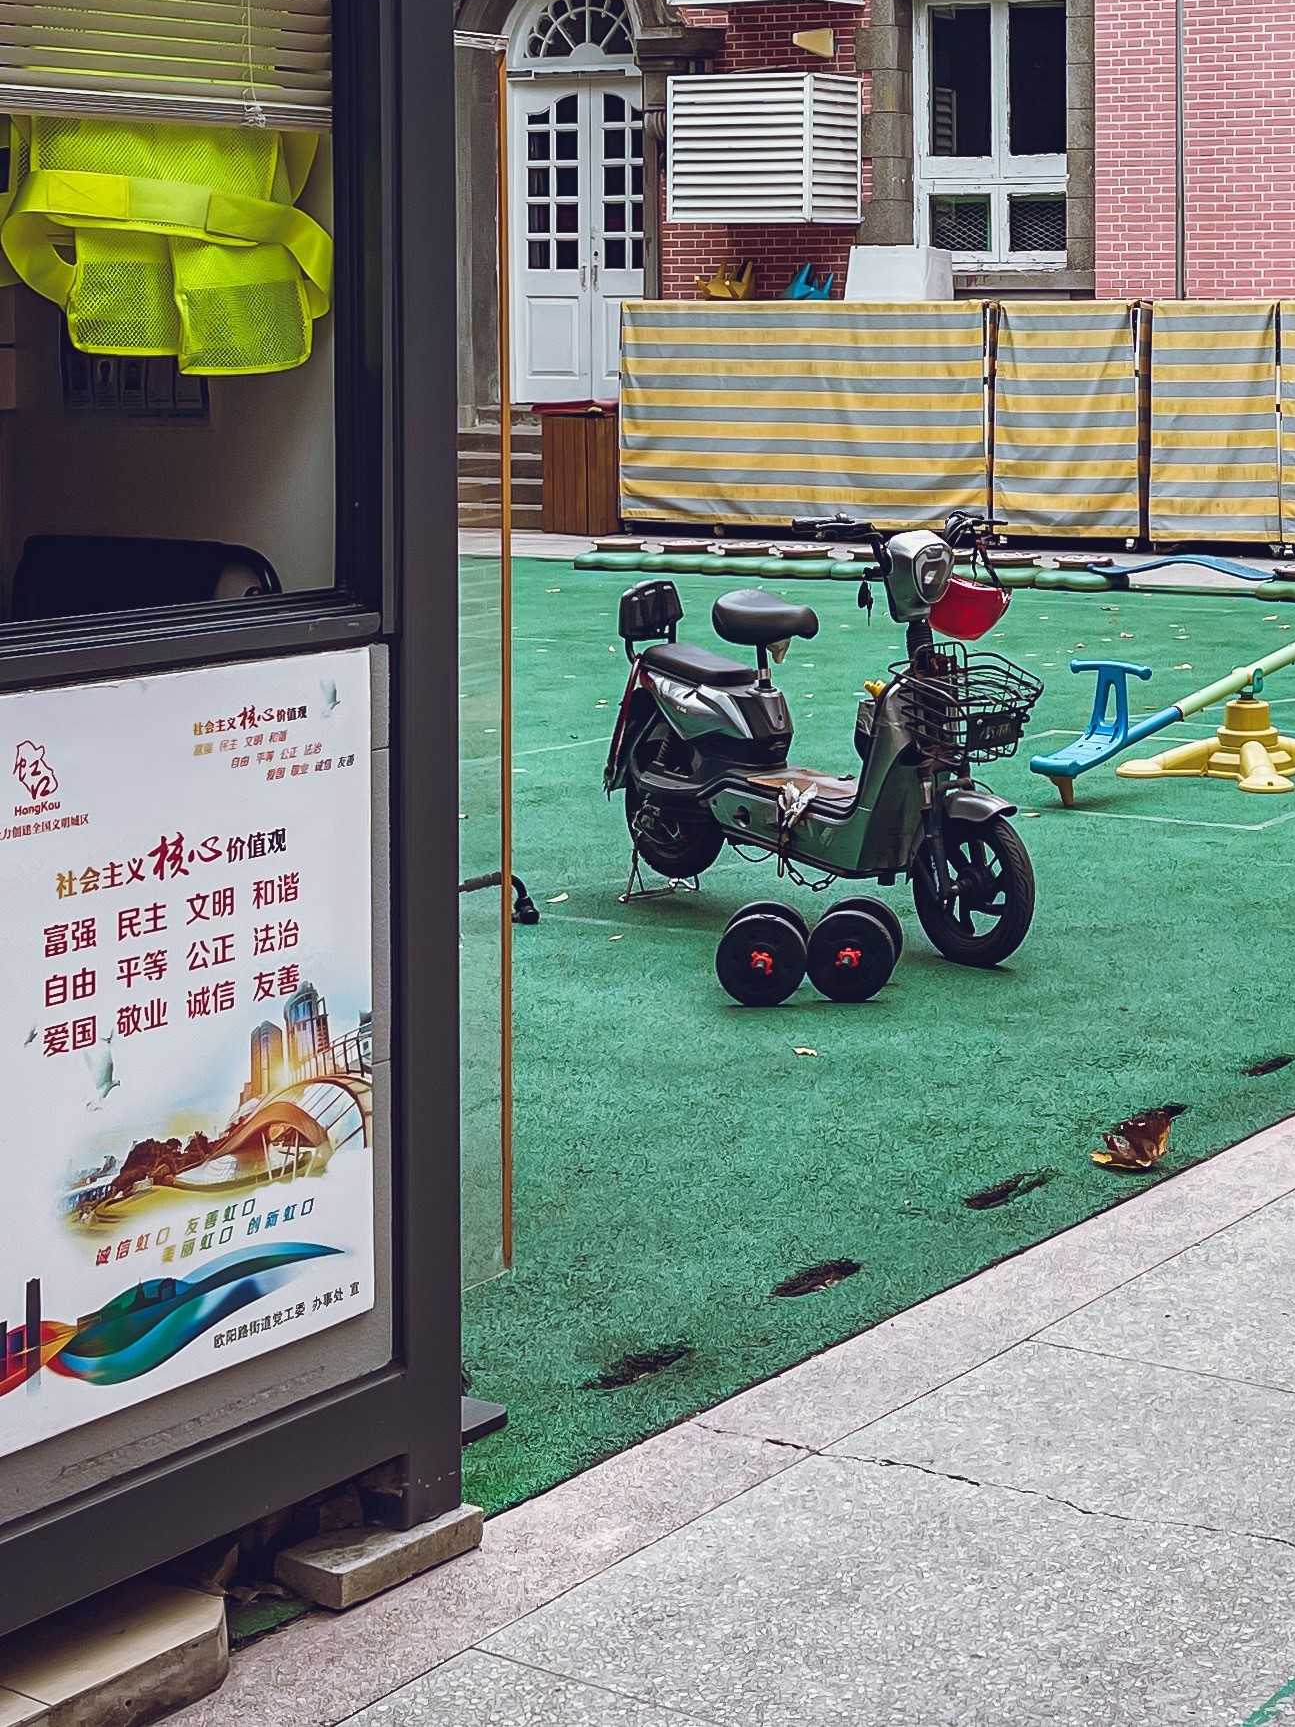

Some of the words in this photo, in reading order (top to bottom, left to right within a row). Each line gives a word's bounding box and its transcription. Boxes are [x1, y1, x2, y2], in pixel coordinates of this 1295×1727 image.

[14, 800, 61, 817] HongKou
[56, 828, 288, 900] 社会主义核心价值观
[43, 917, 98, 958] 富强
[117, 902, 168, 942] 民主
[185, 886, 235, 926] 文明
[252, 872, 300, 910] 和谐
[44, 967, 97, 1007] 自由
[117, 949, 168, 989] 平等
[185, 933, 236, 972] 公正
[252, 919, 300, 957] 法治
[43, 1015, 97, 1057] 爱国
[116, 998, 168, 1038] 敬业
[185, 980, 236, 1018] 诚信
[252, 964, 300, 1003] 友善
[184, 1197, 257, 1236] 友善虹口
[246, 1197, 315, 1236] 创新虹口
